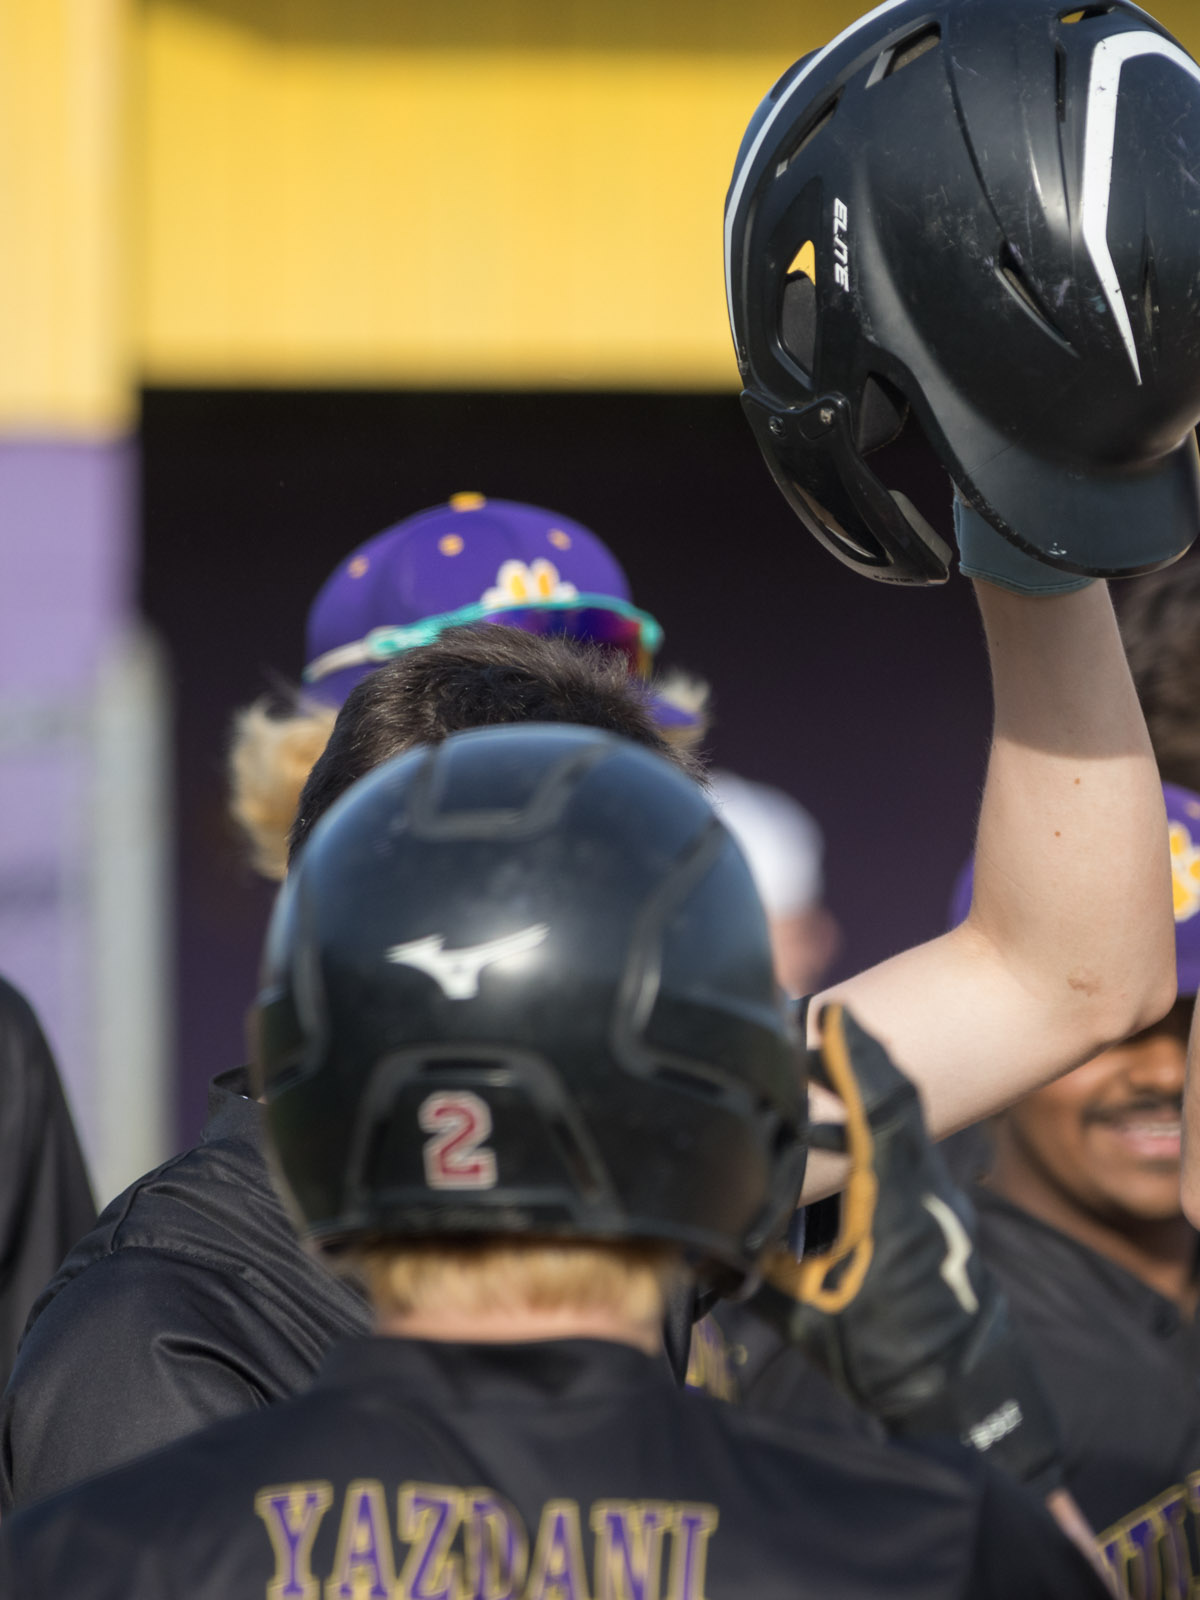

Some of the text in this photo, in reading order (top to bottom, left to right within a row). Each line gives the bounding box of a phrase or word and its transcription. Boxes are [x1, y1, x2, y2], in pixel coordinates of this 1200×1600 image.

[834, 197, 850, 292] ELITE
[417, 1089, 498, 1190] 2
[255, 1478, 719, 1600] YAZDANI
